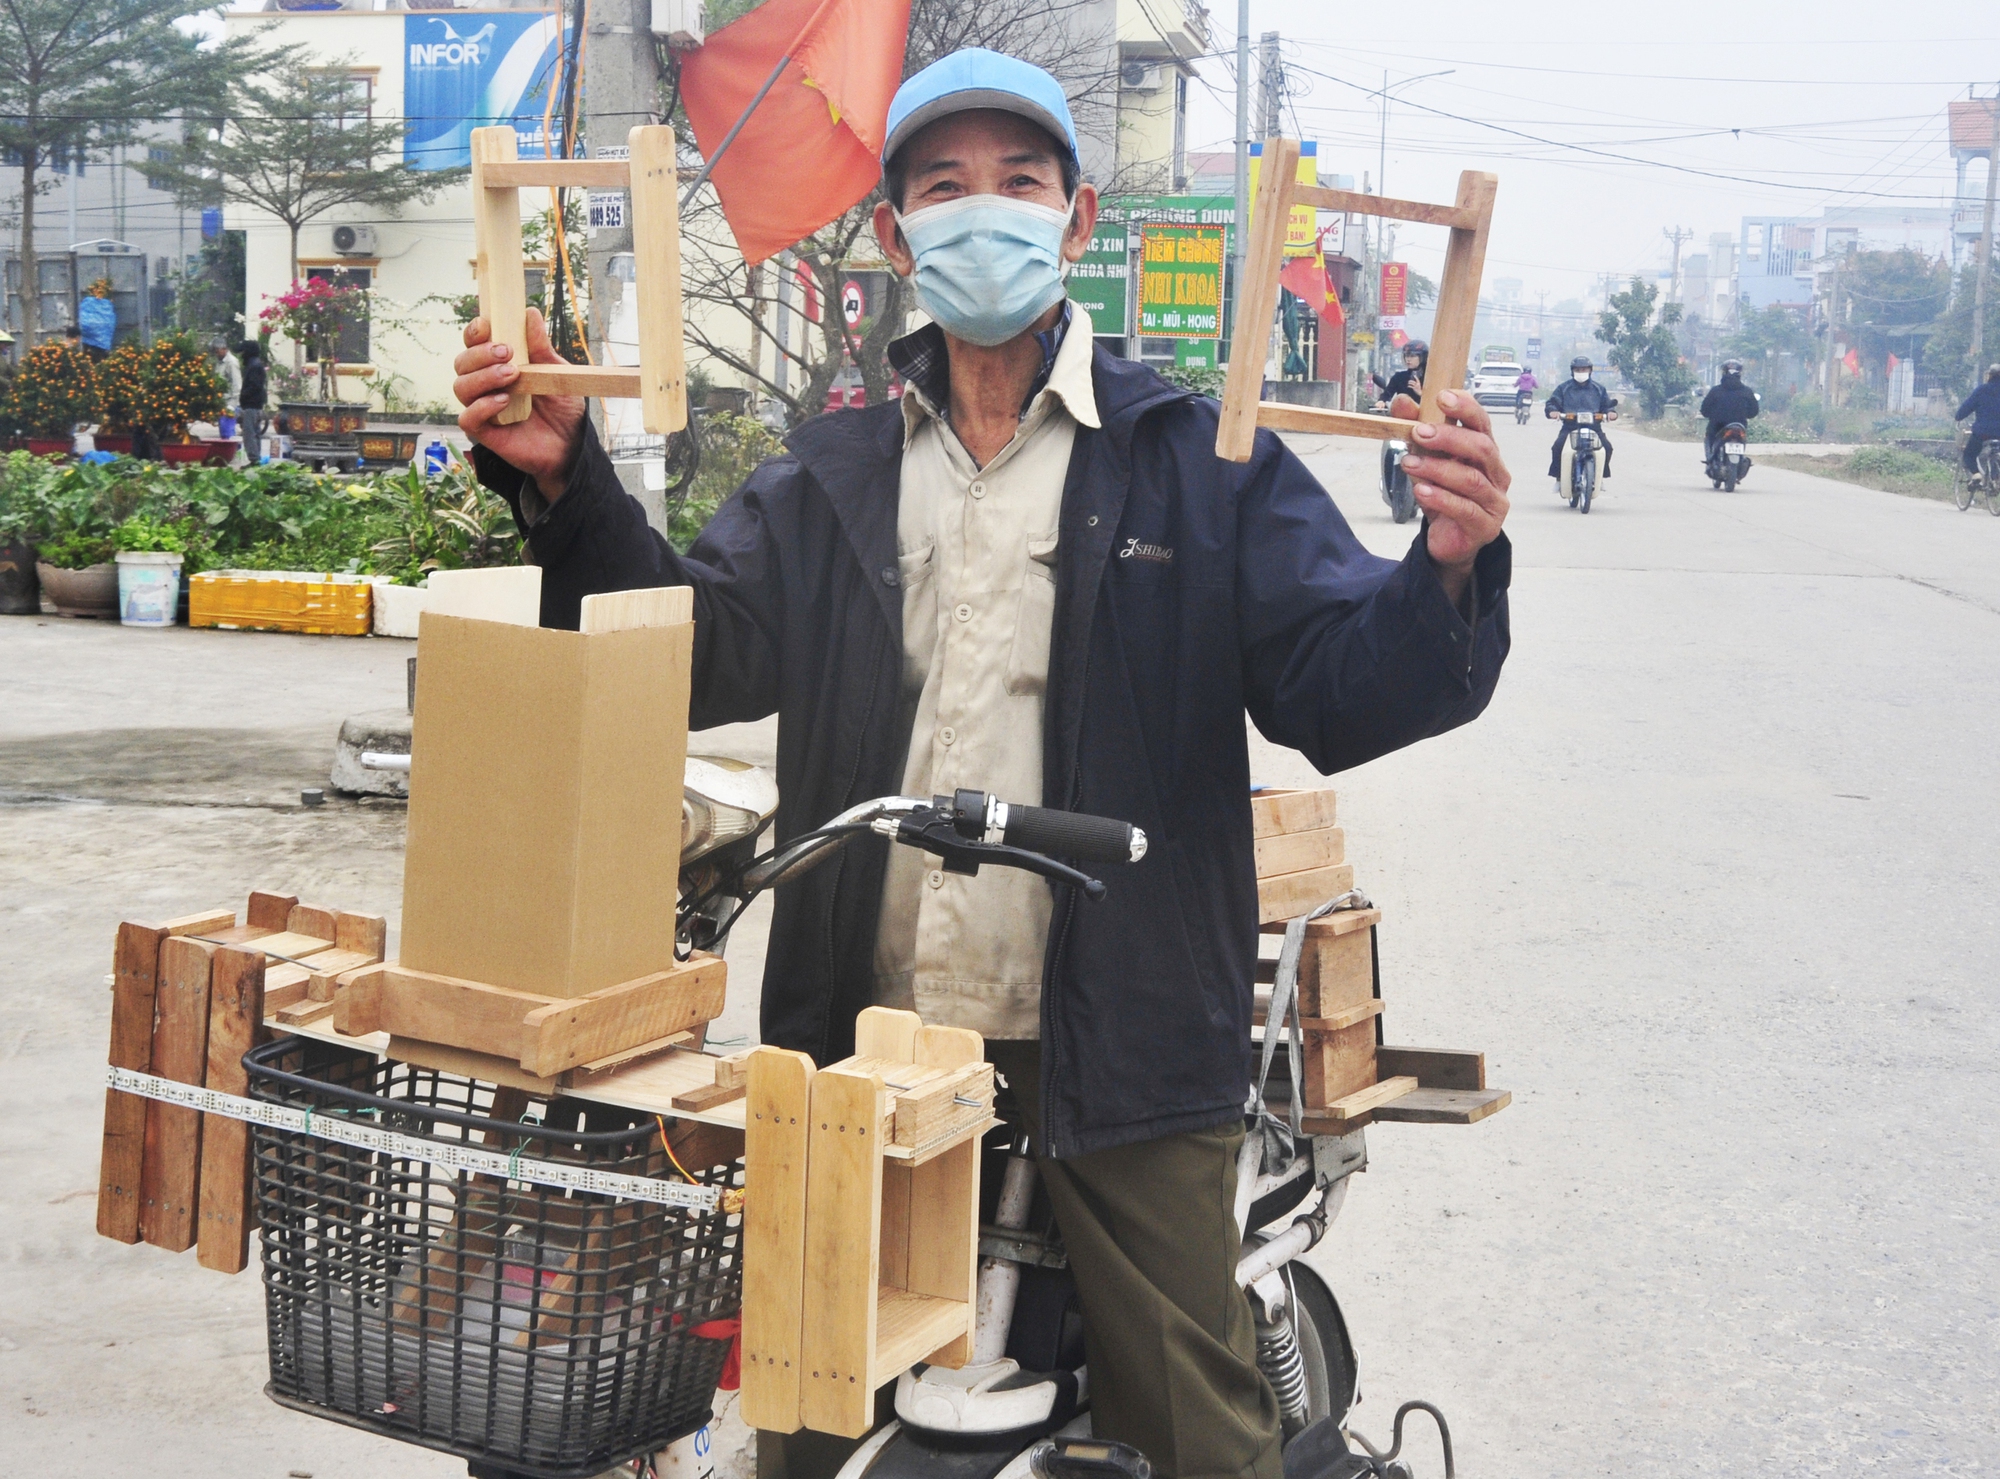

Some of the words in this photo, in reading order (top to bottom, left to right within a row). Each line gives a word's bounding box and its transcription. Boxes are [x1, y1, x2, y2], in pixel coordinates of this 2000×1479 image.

[410, 43, 481, 65] INFOR
[1201, 209, 1236, 223] DUN
[1102, 238, 1124, 252] XIN
[1071, 263, 1105, 278] KHOA
[1143, 272, 1173, 304] NHI
[1174, 272, 1218, 306] KHOA
[1142, 313, 1156, 327] TAI
[1162, 310, 1181, 328] MŨI
[1187, 314, 1217, 333] HỌNG
[1185, 356, 1207, 368] DỤNG
